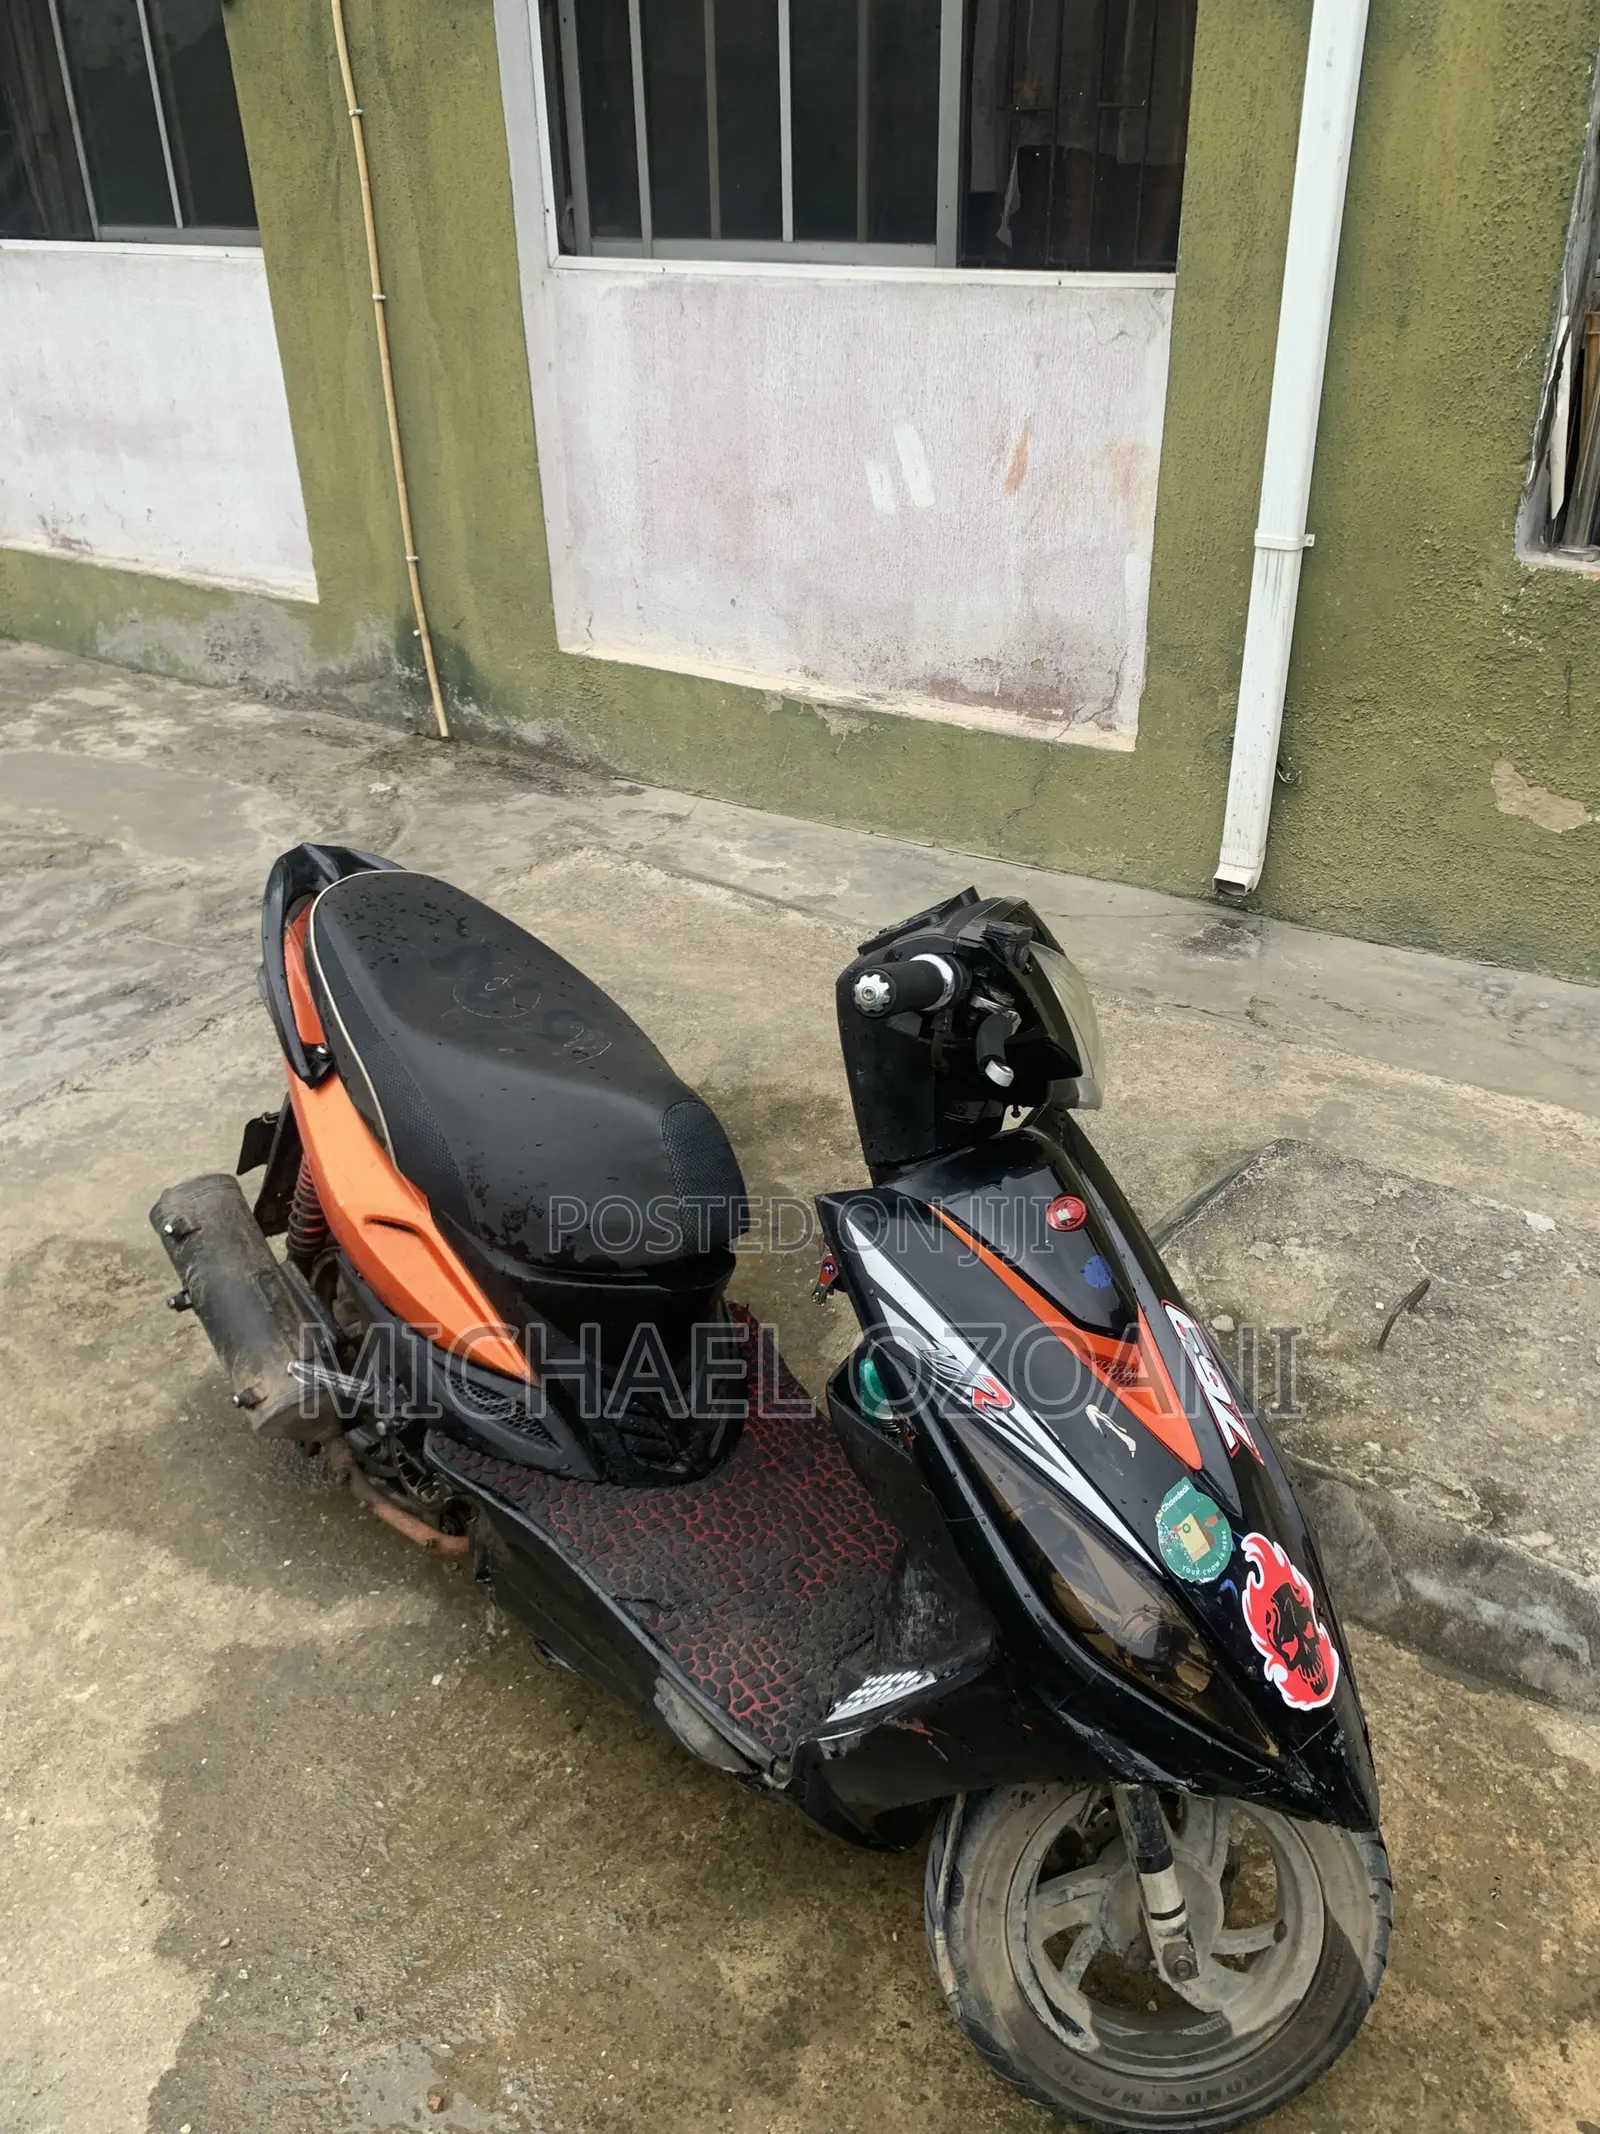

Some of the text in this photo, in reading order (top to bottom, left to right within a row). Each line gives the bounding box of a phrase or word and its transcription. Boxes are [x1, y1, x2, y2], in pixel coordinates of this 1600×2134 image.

[1160, 1484, 1191, 1512] Chowdeck
[1182, 1565, 1200, 1576] YOUR
[1202, 1560, 1221, 1576] CHOW
